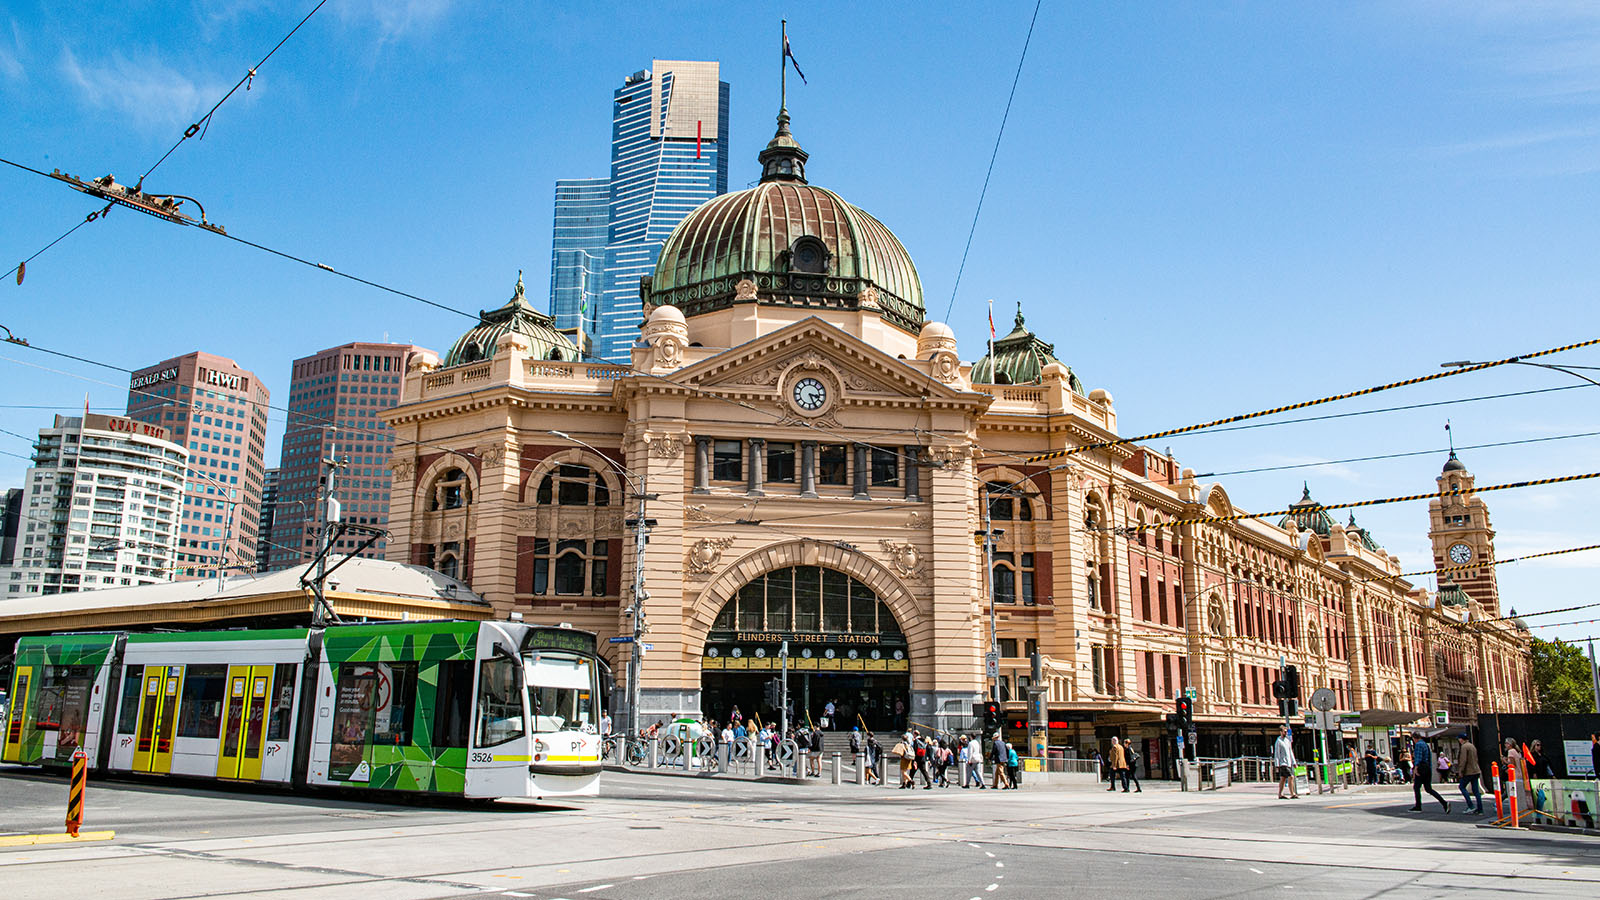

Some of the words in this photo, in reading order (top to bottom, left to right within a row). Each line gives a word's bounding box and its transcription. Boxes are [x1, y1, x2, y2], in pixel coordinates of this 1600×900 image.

[161, 367, 178, 381] SUN
[109, 419, 138, 433] QUAY
[143, 424, 164, 439] WEST
[533, 639, 549, 648] City
[737, 632, 783, 642] FLINDERS
[793, 633, 828, 643] STREET
[838, 634, 879, 644] STATION
[471, 752, 493, 763] 3526
